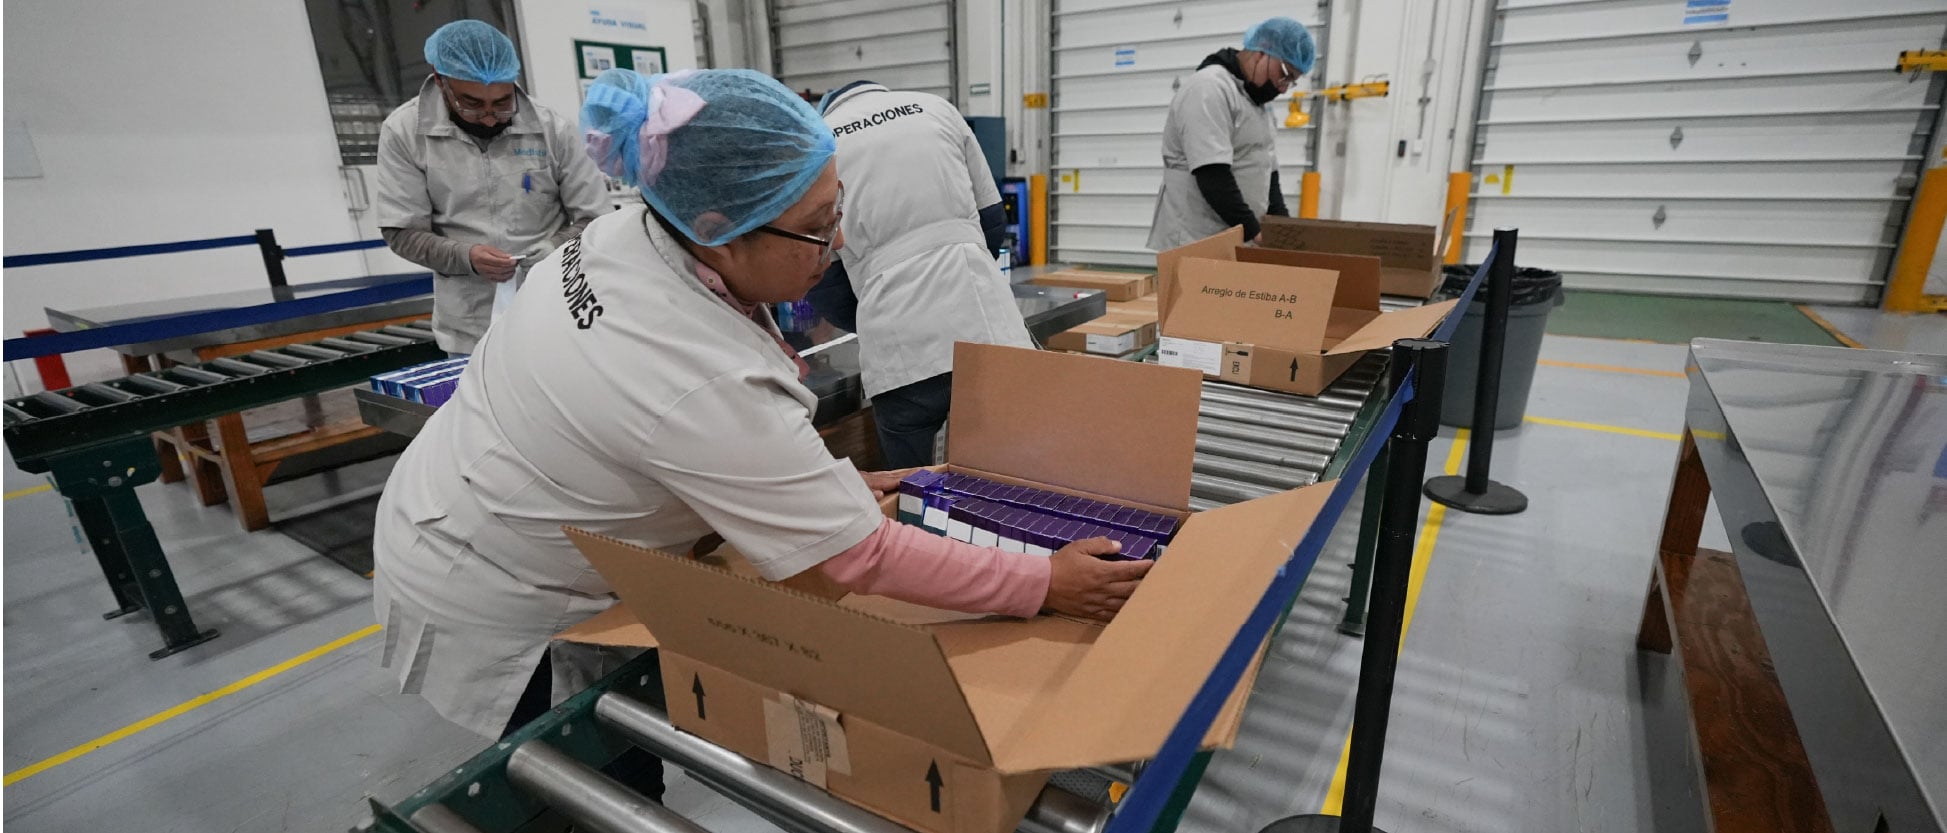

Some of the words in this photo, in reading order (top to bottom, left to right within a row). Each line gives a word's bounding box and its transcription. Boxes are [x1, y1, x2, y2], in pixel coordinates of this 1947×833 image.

[832, 103, 924, 138] PERACIONES
[562, 234, 604, 330] ERACIONES
[1201, 285, 1233, 298] Arreglo
[1235, 289, 1247, 299] de
[1249, 290, 1277, 302] Estiba
[1279, 293, 1297, 304] A-B
[1274, 309, 1293, 320] B-A
